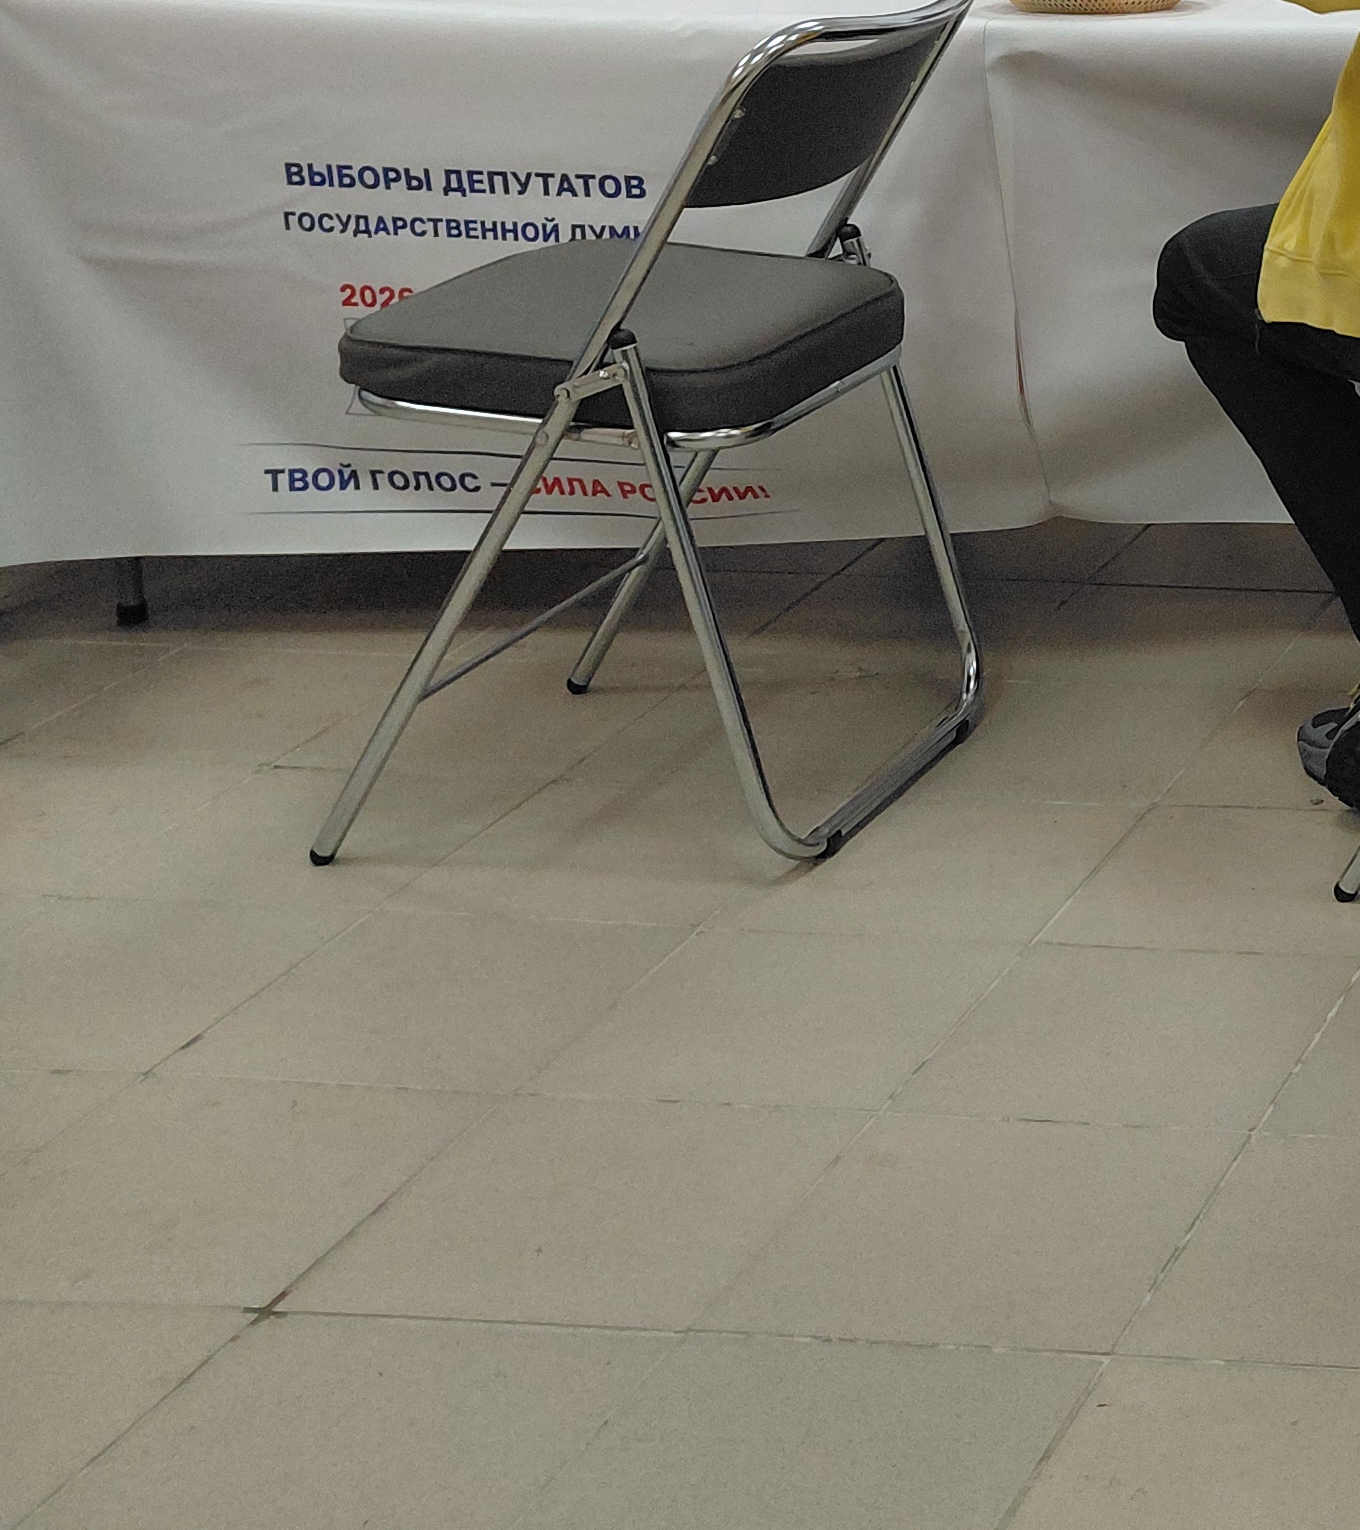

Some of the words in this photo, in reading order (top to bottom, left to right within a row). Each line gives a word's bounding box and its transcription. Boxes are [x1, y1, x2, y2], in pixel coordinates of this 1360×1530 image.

[285, 162, 433, 192] ВЫБОРЫ
[442, 168, 647, 199] ДЕПУТАТОВ
[283, 211, 560, 243] ГОСУДАРСТВЕННОЙ
[264, 464, 360, 492] ТВОЙ
[370, 470, 481, 493] ГОЛОС
